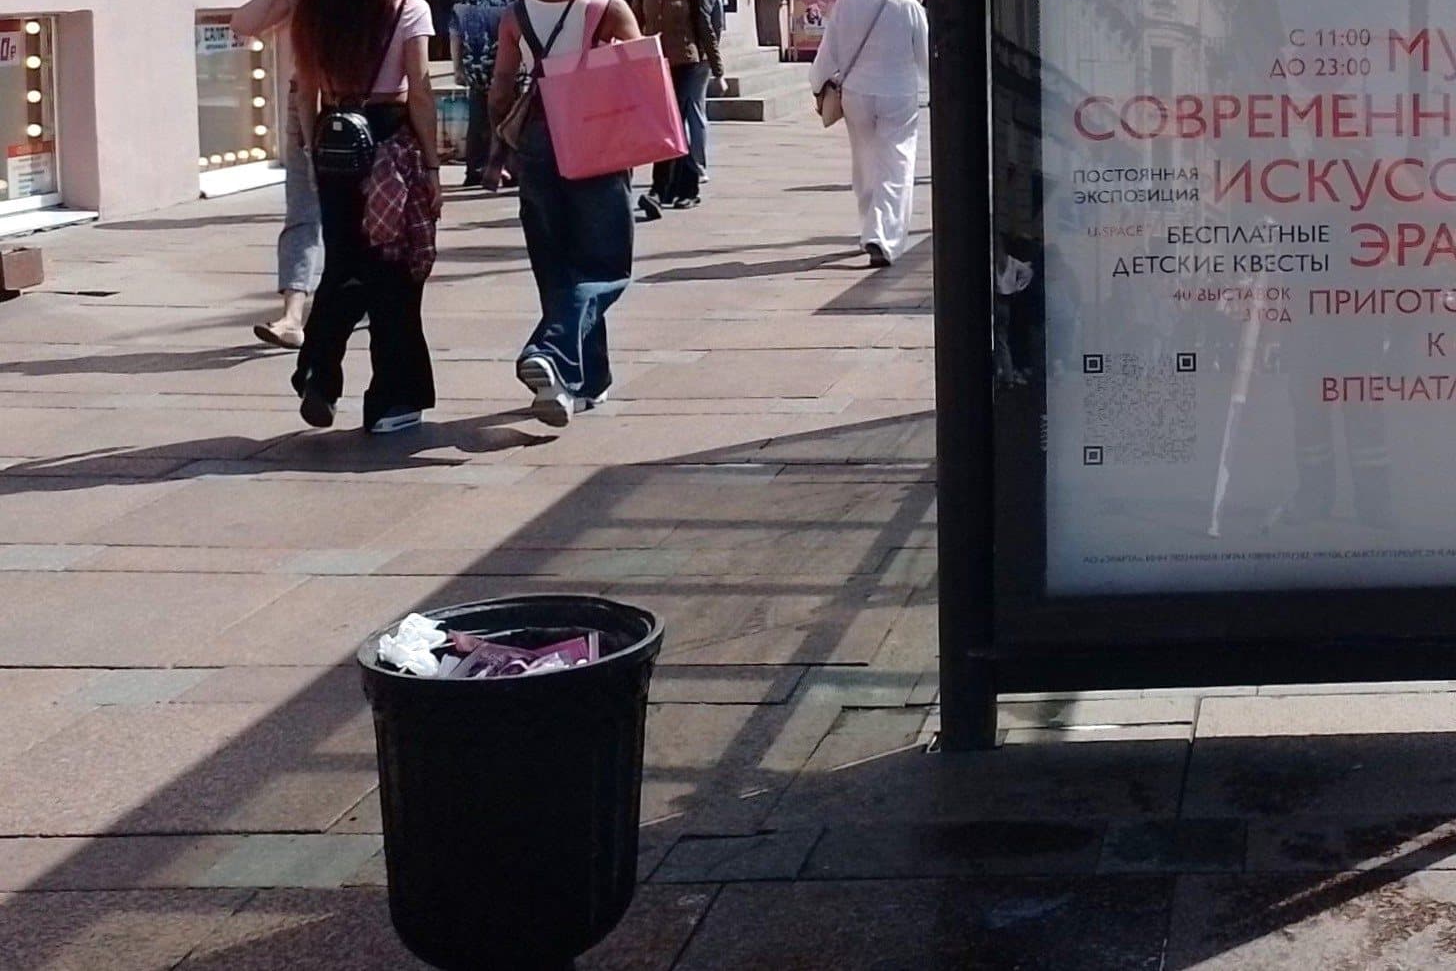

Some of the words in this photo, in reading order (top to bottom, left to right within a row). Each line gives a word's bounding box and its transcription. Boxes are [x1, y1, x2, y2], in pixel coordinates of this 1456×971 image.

[1289, 29, 1306, 47] С
[1315, 29, 1371, 47] 11:00
[1269, 58, 1306, 79] ДО
[1314, 58, 1371, 77] 23:00
[1073, 167, 1199, 184] ПОСТОЯННАЯ
[1073, 188, 1199, 205] ЭКСПОЗИЦИЯ
[1167, 225, 1330, 245] БЕСПЛАТНЫЕ
[1112, 255, 1225, 277] ДЕТСКИЕ
[1233, 254, 1329, 273] КВЕСТЫ
[1197, 287, 1292, 302] ВЫСТАОК
[1427, 332, 1445, 357] К
